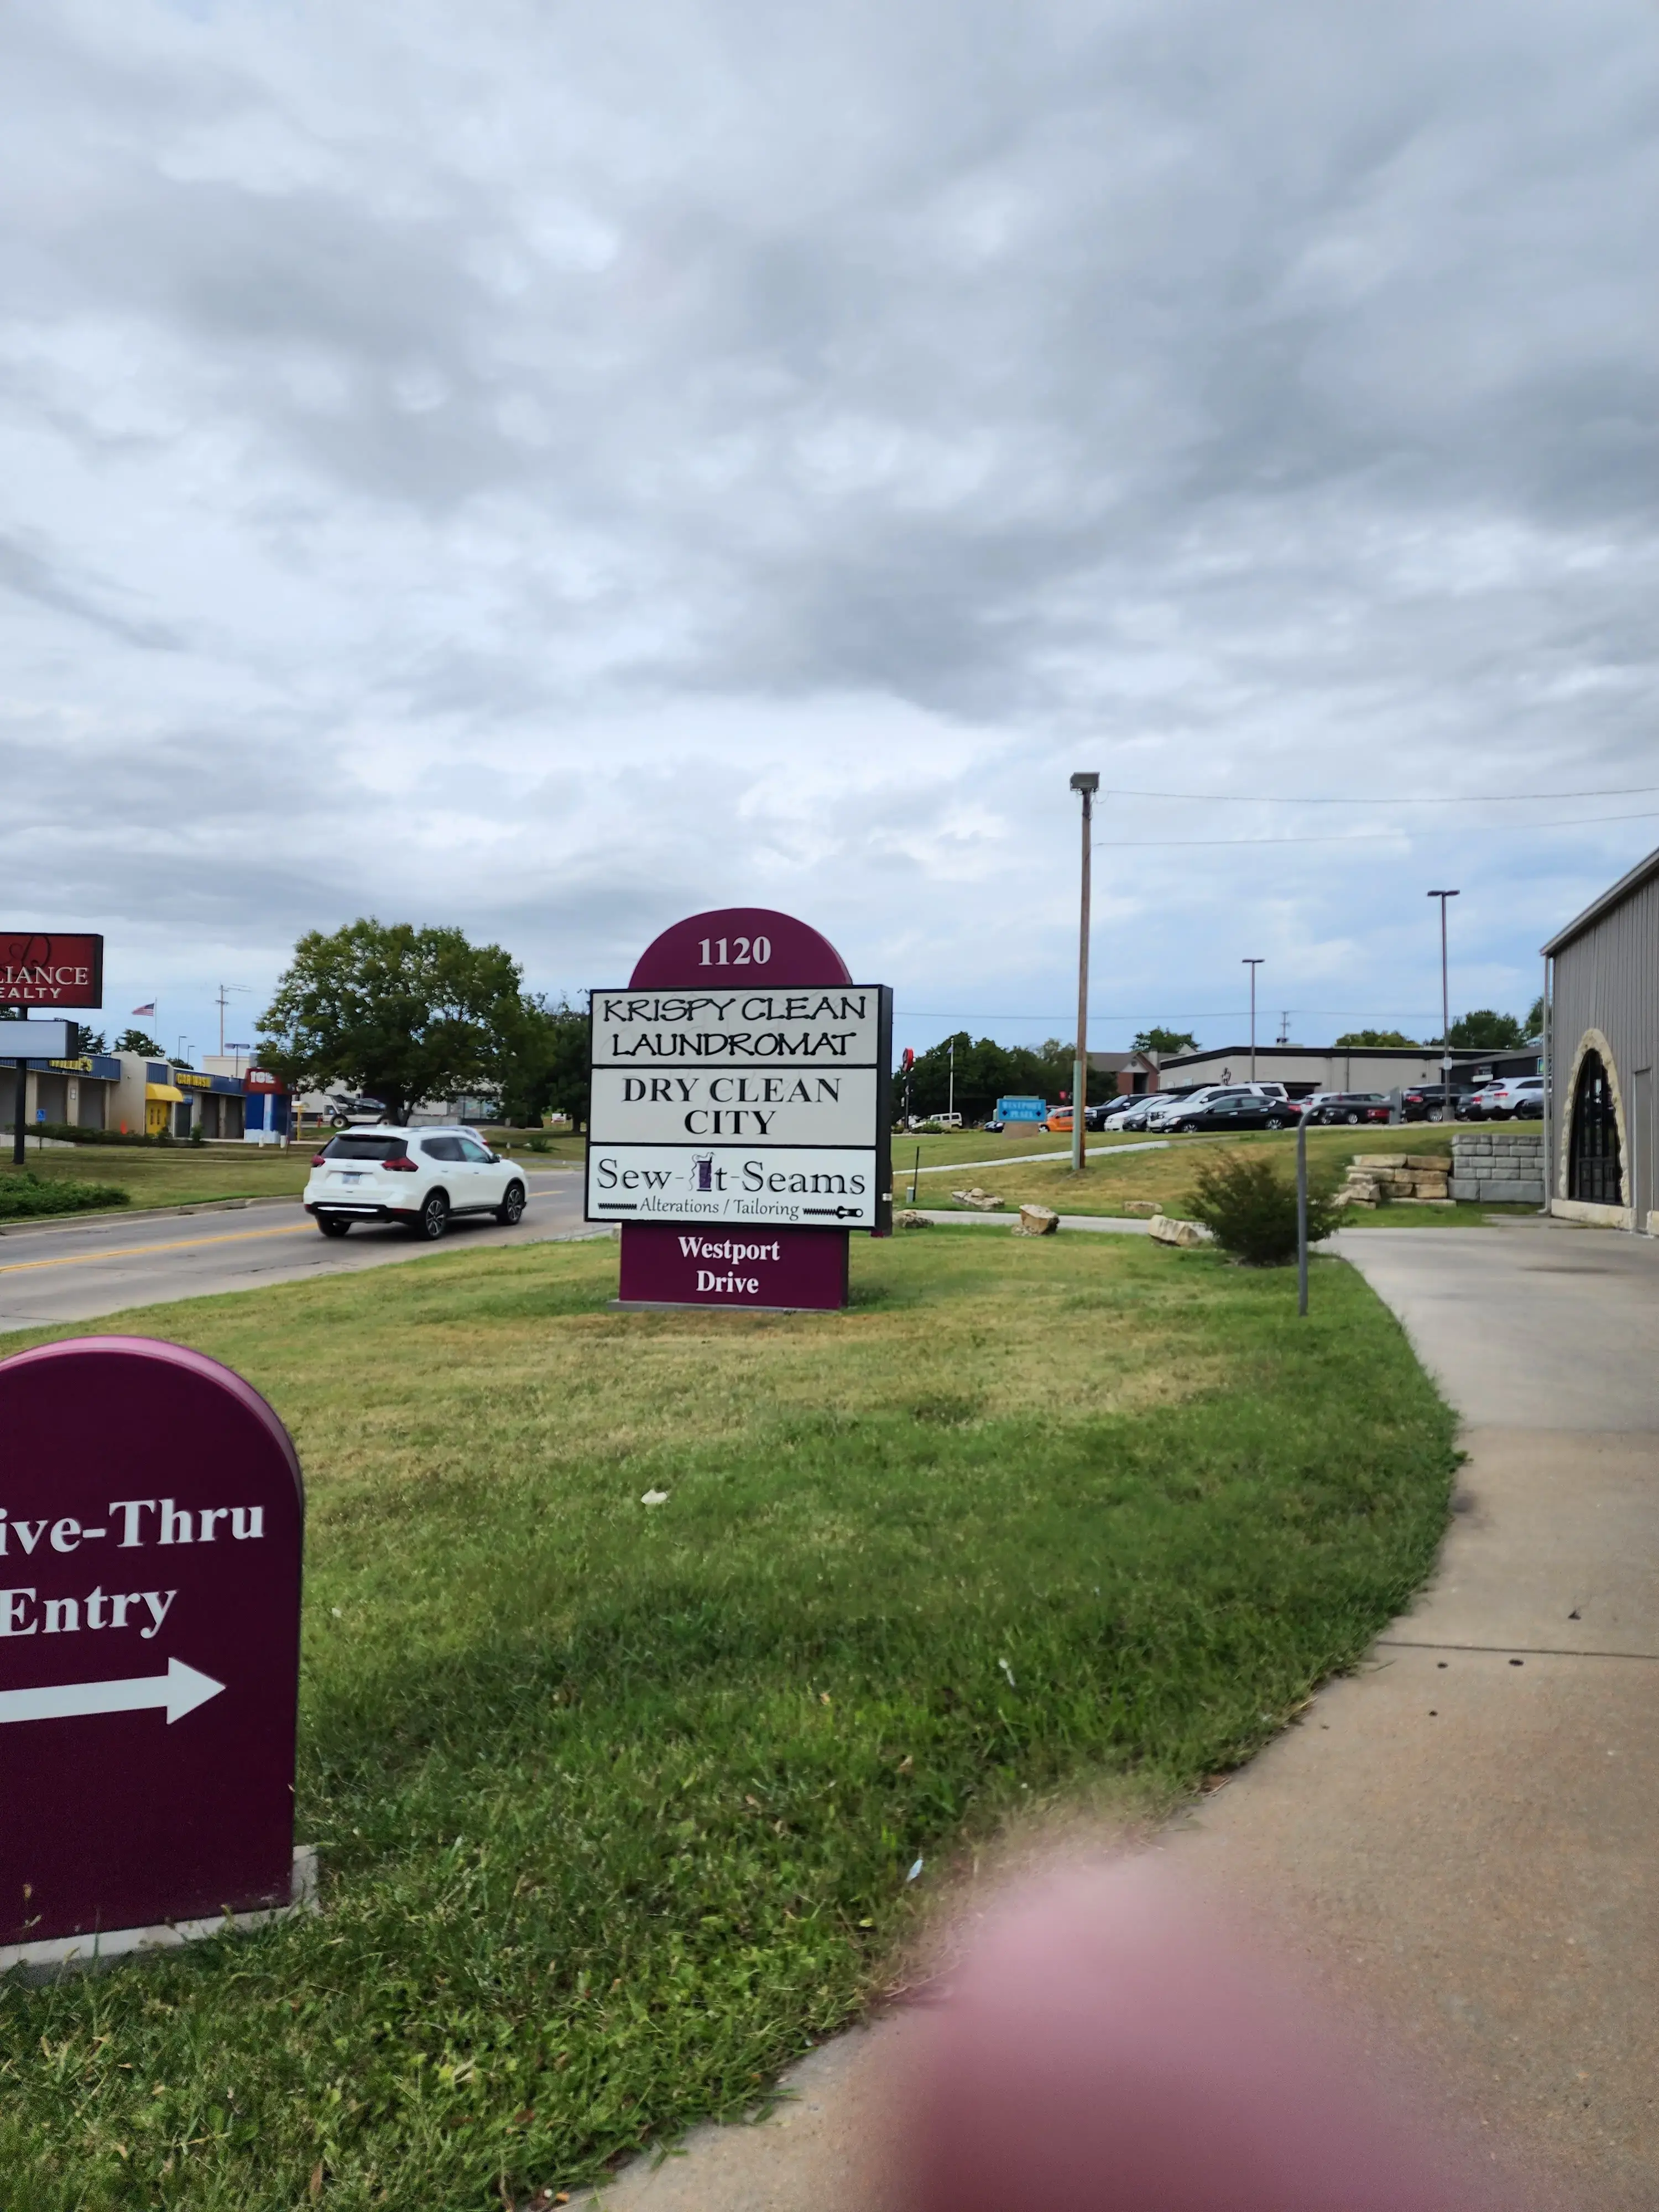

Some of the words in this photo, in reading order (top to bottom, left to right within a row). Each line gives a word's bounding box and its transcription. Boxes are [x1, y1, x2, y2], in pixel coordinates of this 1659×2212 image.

[698, 936, 771, 966] 1120
[603, 998, 736, 1022] KRISPY
[742, 996, 866, 1021] CLEAN
[612, 1032, 857, 1056] LAUNDROMAT
[176, 1073, 191, 1085] CAR
[192, 1075, 211, 1088] WASH
[251, 1071, 274, 1084] ICE
[621, 1078, 700, 1102] DRY
[709, 1078, 842, 1103] CLEAN
[684, 1109, 777, 1135] CITY
[639, 1196, 719, 1214] Alterations
[733, 1198, 800, 1222] Tailoring
[677, 1237, 781, 1265] Westport
[696, 1270, 759, 1294] Drive
[0, 1585, 179, 1639] Entry
